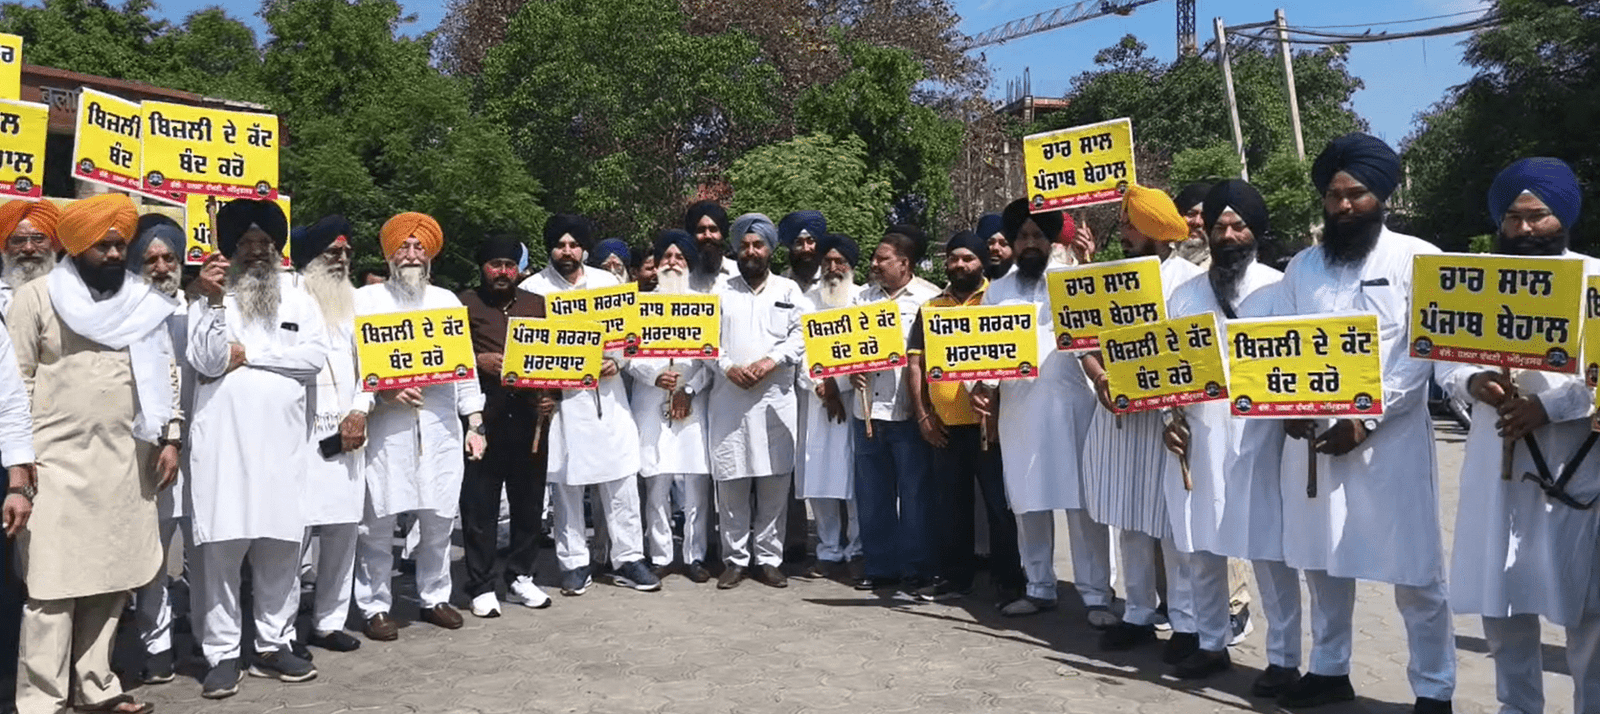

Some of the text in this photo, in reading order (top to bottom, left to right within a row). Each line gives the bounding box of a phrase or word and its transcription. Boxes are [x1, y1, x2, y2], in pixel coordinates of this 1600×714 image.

[87, 101, 141, 139] ਬਿਜਲੀ
[149, 111, 272, 147] ਬਿਜਲੀ ਦੇ ਕੱਟ
[110, 141, 133, 168] ਬੰਦ
[1042, 132, 1113, 160] ਚਾਰ ਸਾਲ
[180, 147, 244, 177] ਬੰਦ ਕਰੋ
[1034, 160, 1128, 190] ਪੰਜਾਬ ਬੇਹਾਲ
[1065, 271, 1140, 296] ਚਾਰ ਸਾਲ
[1439, 266, 1554, 296] ਚਾਰ ਸਾਲ
[551, 291, 635, 315] ਪੰਜਾਬ ਸਰਕਾਰ
[672, 302, 715, 316] ਸਰਕਾਰ
[1058, 300, 1158, 329] ਪੰਜਾਬ ਬੇਹਾਲ
[362, 315, 464, 343] ਬਿਜਲੀ ਦੇ ਕੱਟ
[513, 323, 601, 345] ਪੰਜਾਬ ਸਰਕਾਰ
[642, 326, 702, 344] ਮੁਰਦਾਬਾਦ
[807, 309, 896, 337] ਬਿਜਲੀ ਦੇ ਕੱਟ
[929, 313, 1031, 334] ਪੰਜਾਬ ਸਰਕਾਰ
[1420, 301, 1570, 343] ਪੰਜਾਬ ਬੇਹਾਲ
[832, 336, 879, 358] ਬੰਦ ਕਰੋ
[946, 343, 1016, 366] ਮੁਰਦਾਬਾਦ
[1106, 323, 1213, 362] ਬਿਜਲੀ ਦੇ ਕੱਟ
[1234, 325, 1372, 358] ਬਿਜਲੀ ਦੇ ਕੱਟ
[390, 345, 444, 369] ਬੰਦ ਕਰੋ
[524, 354, 585, 373] ਮੁਰਦਾਬਾਦ
[1136, 358, 1193, 389] ਬੰਦ ਕਰੋ
[1267, 363, 1340, 393] ਬੰਦ ਕਰੋ
